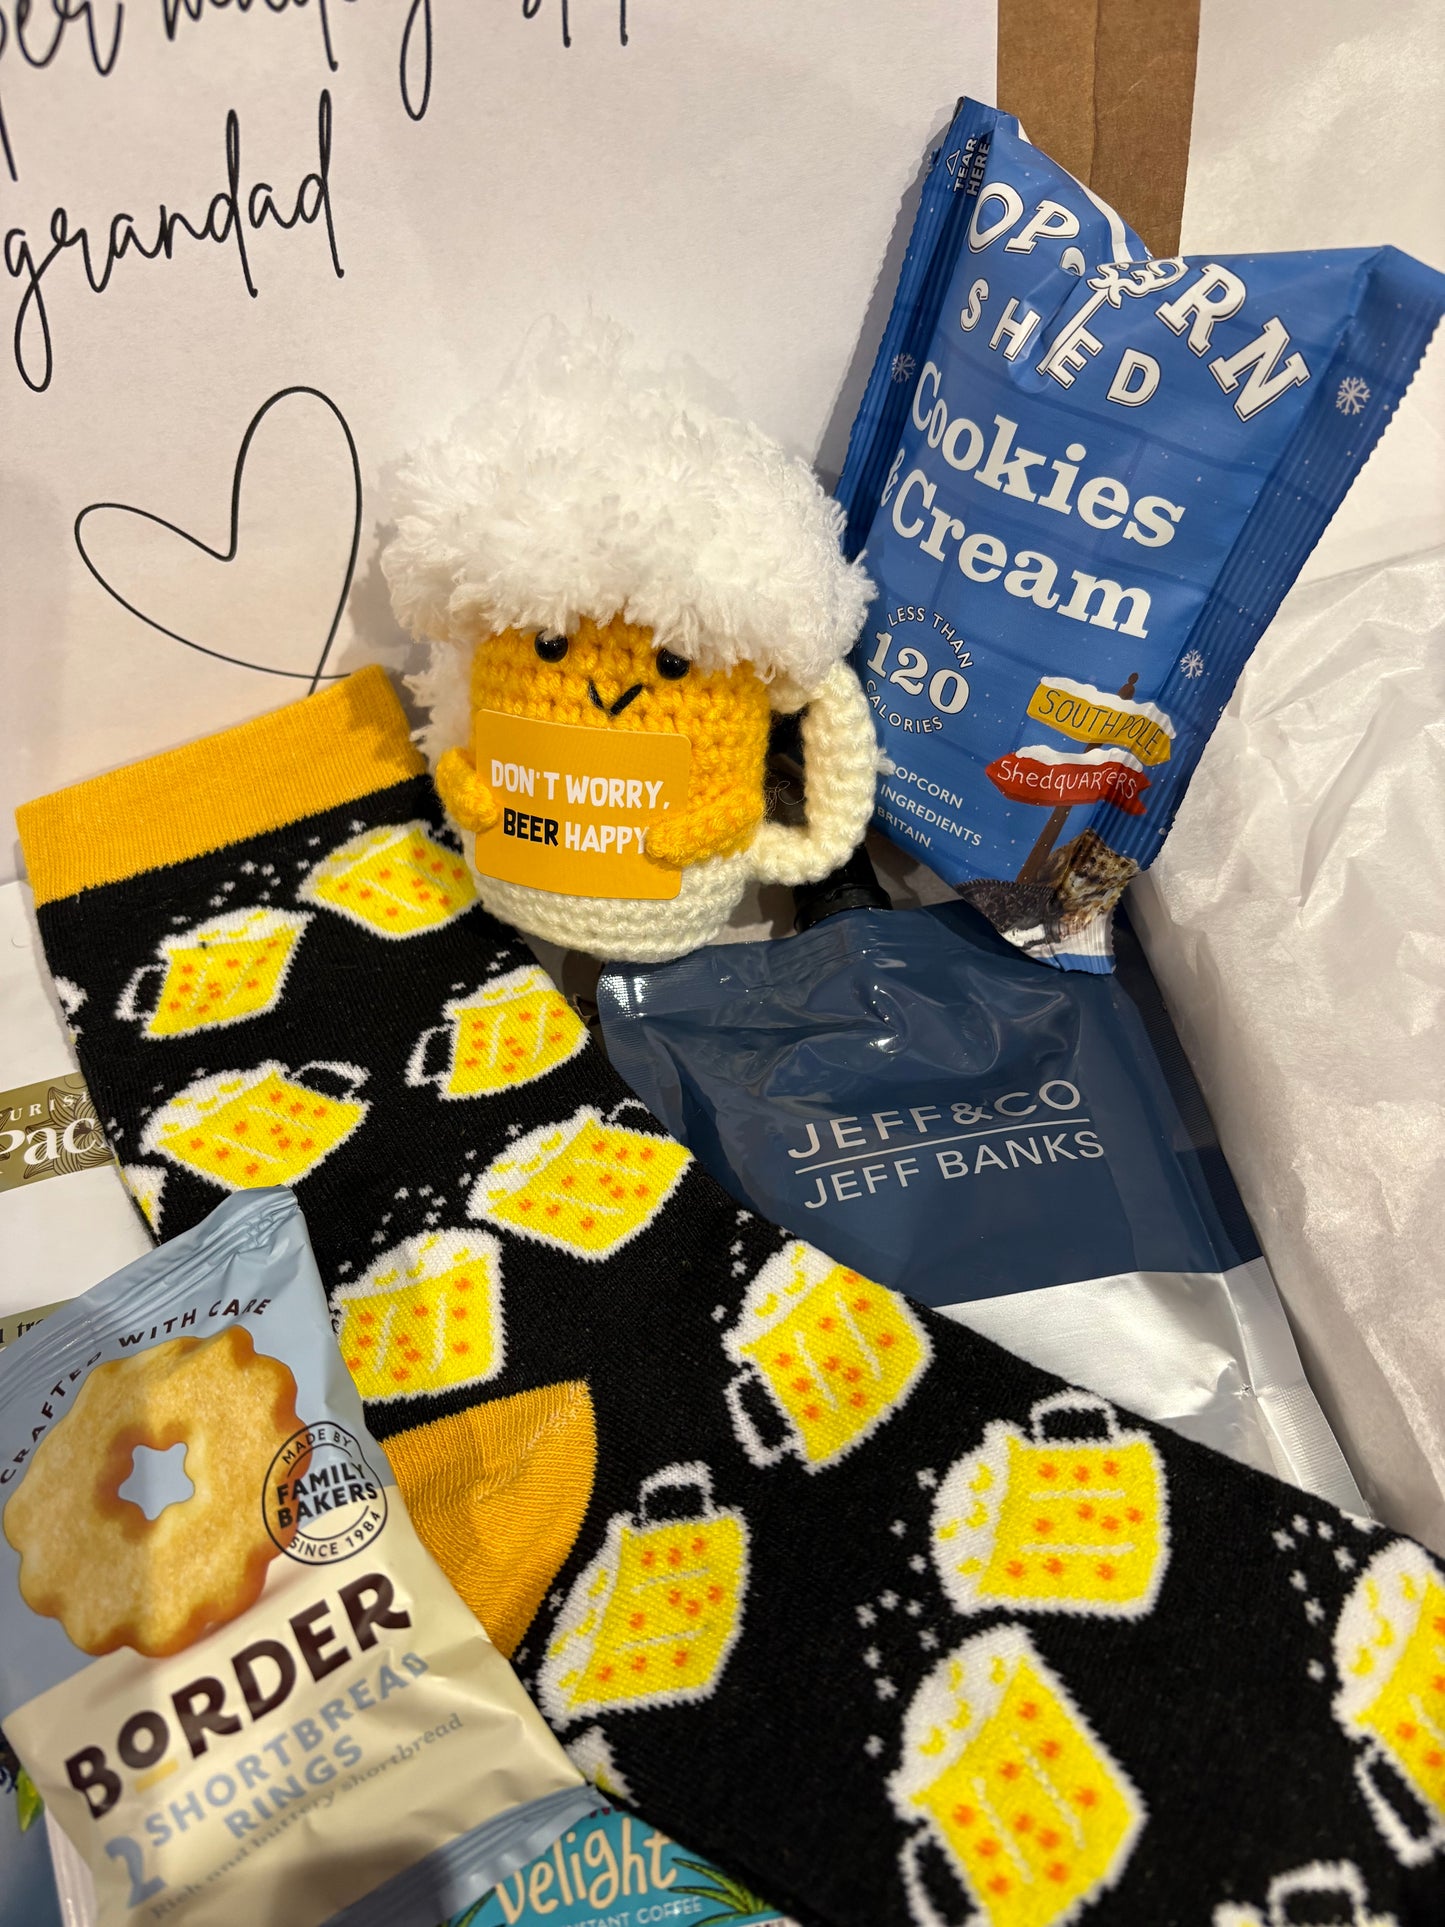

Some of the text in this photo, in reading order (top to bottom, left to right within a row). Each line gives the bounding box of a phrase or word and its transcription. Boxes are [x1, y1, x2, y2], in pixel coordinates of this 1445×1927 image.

[953, 138, 978, 192] TEAR
[966, 142, 991, 197] HERE
[4, 89, 345, 392] grandad
[960, 278, 1161, 407] SHED
[912, 361, 1186, 547] Cookies
[892, 469, 1151, 639] Cream
[888, 606, 974, 669] LESS THAN
[866, 631, 970, 715] 120
[866, 679, 943, 734] CALORIES
[491, 759, 671, 810] DON'T WORRY,
[880, 784, 982, 846] INGREDIENTS
[895, 766, 963, 809] OPCORN
[503, 807, 649, 855] BEER HAPPY
[0, 1091, 88, 1122] URIS
[804, 1130, 1105, 1209] JEFF BANKS
[0, 1298, 272, 1485] CRAFTED WITH CARE
[282, 1428, 352, 1464] MADE BY
[276, 1462, 366, 1505] FAMILY
[277, 1482, 378, 1529] BAKERS
[289, 1511, 381, 1557] SINCE 1984
[65, 1573, 412, 1820] BORDER
[105, 1652, 430, 1911] 2 SHORTBREAD
[339, 1712, 465, 1793] shortbread
[223, 1735, 363, 1840] RINGS
[636, 1895, 703, 1924] COFFEE
